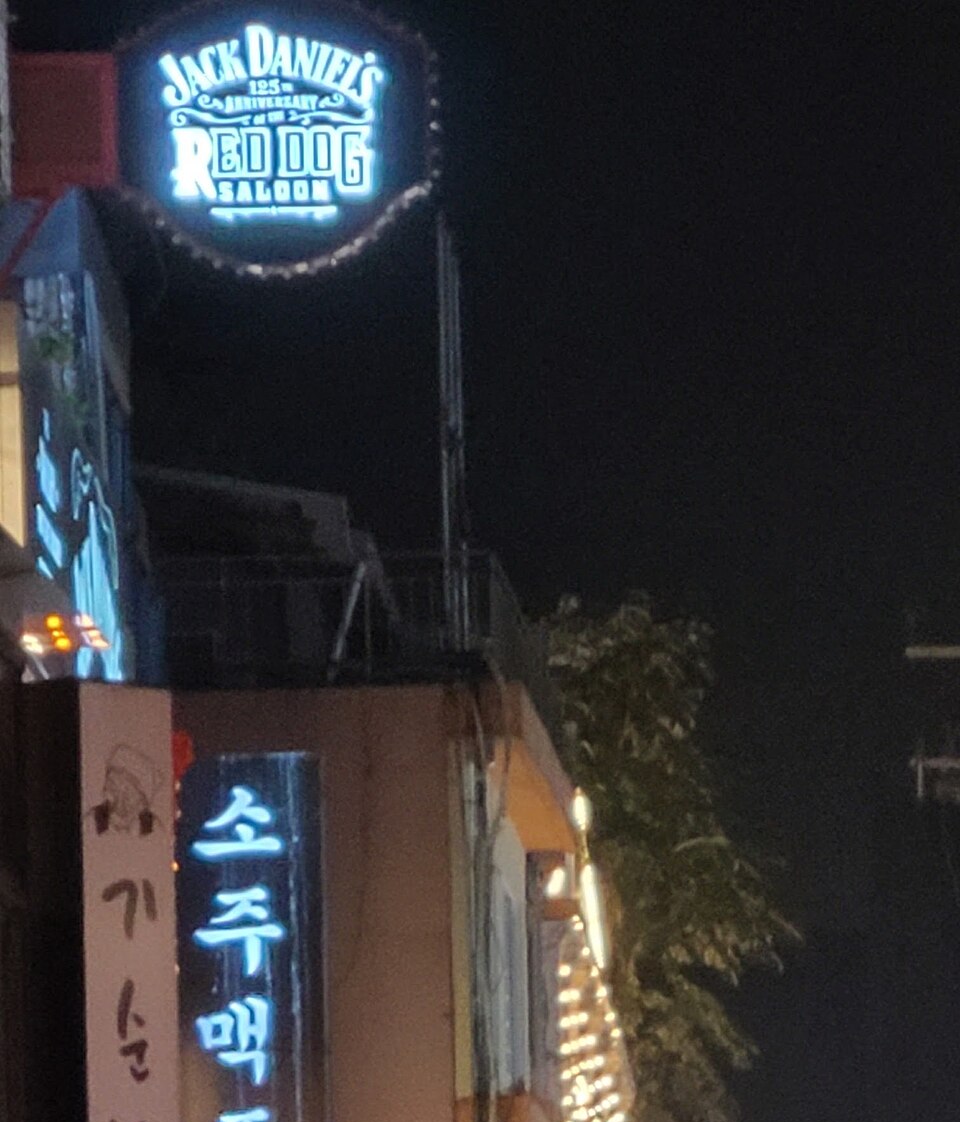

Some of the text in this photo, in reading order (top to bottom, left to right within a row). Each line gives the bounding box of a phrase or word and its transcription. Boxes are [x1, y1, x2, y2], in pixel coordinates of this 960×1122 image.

[158, 24, 384, 108] JACK DANIEL'S
[171, 125, 375, 200] RED DOG
[217, 180, 330, 201] SALOON
